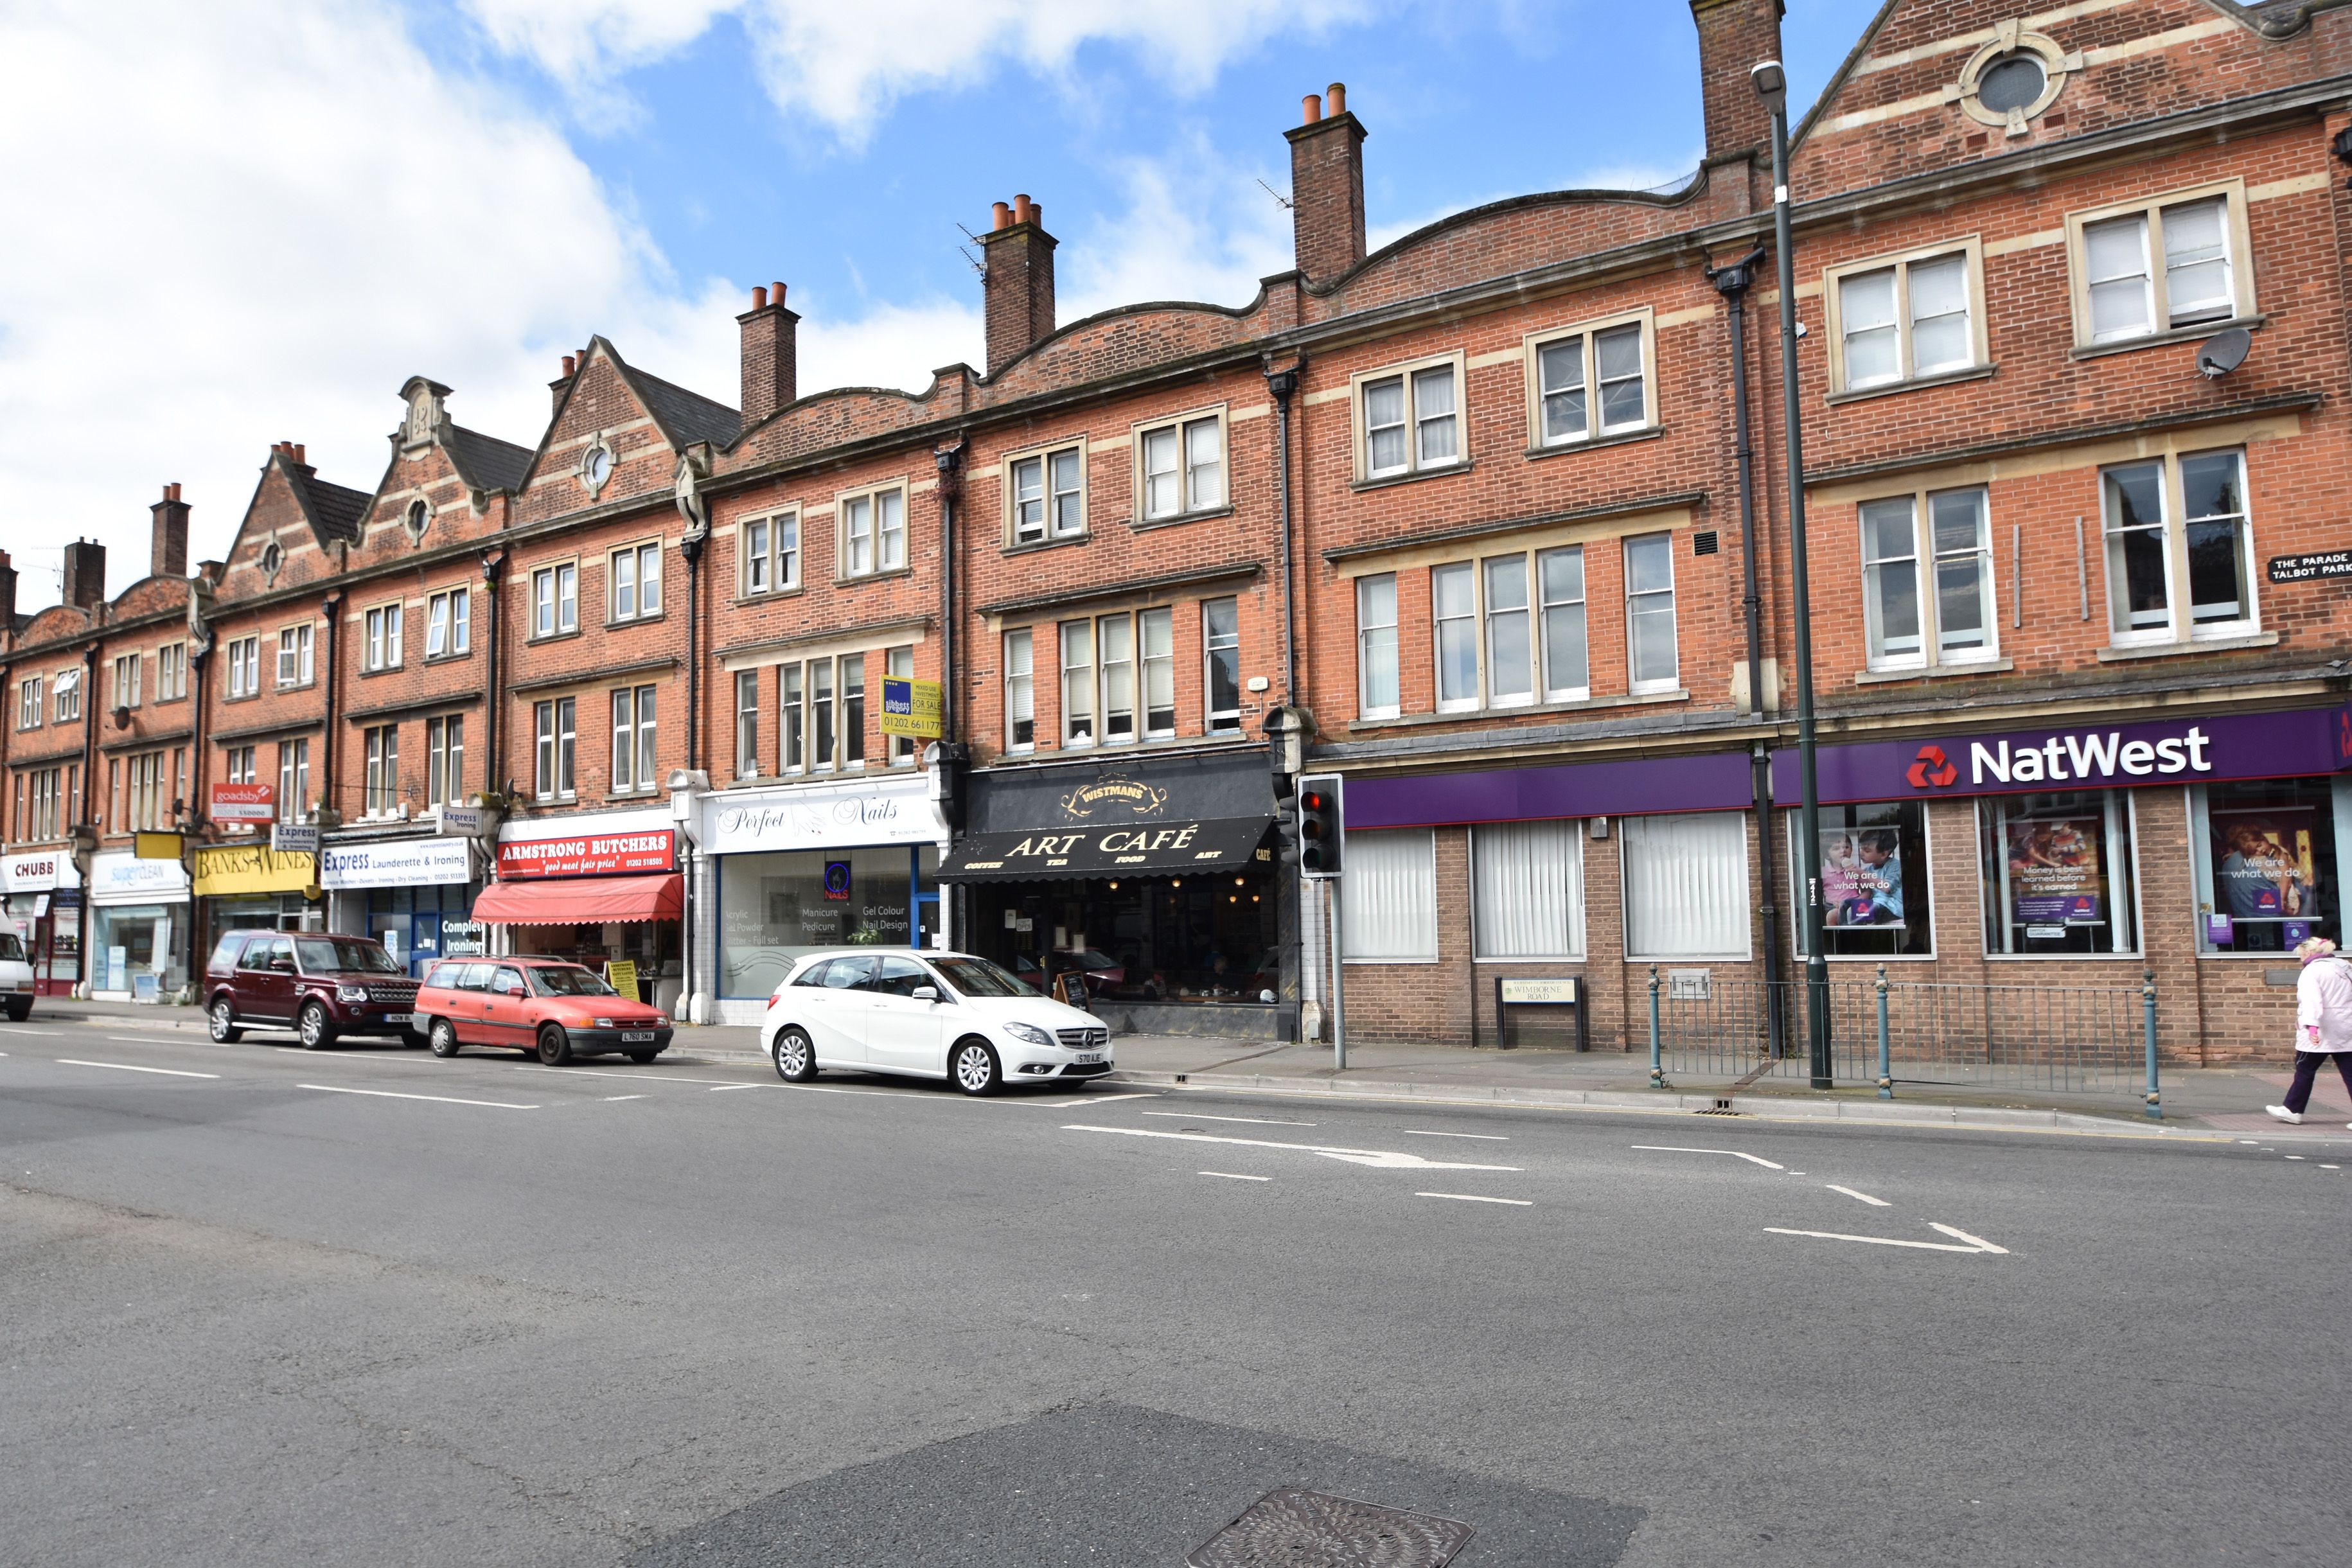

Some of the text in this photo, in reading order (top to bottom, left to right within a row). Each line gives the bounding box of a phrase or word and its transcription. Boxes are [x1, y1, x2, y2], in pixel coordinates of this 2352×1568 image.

[2275, 553, 2348, 569] THE PARADE
[2272, 563, 2352, 579] TALBOT PARK
[885, 699, 910, 707] sibbett
[885, 705, 910, 714] gregory
[912, 699, 941, 710] FOR SALE
[884, 716, 940, 730] 01202 661177
[1970, 727, 2211, 784] NatWest
[216, 790, 260, 804] goadsby
[1082, 786, 1144, 803] WISTMANS
[443, 812, 477, 823] Express
[718, 796, 897, 838] Perfect Nails
[279, 825, 315, 839] Express
[456, 822, 477, 830] Ironing
[1005, 824, 1199, 857] ART CAFÉ
[502, 835, 668, 861] ARMSTRONG BUTCHERS
[1256, 847, 1271, 861] CAFÉ
[196, 846, 312, 880] BANKS WINES
[324, 851, 464, 877] Express Launderette & Ironing
[561, 859, 578, 870] meat
[580, 858, 596, 873] fair
[626, 859, 642, 867] 01202
[643, 857, 664, 867] 518505
[964, 850, 1223, 870] COFFEE TEA FOOD ART
[2243, 858, 2262, 867] We
[15, 861, 54, 877] CHUBB
[2023, 867, 2053, 875] Money
[2231, 869, 2262, 878] what
[2285, 867, 2301, 877] do
[1834, 881, 1858, 890] what
[1877, 880, 1890, 888] do
[824, 889, 849, 899] NAILS
[802, 908, 838, 918] Manicure
[862, 905, 905, 916] Gel Colour
[737, 922, 764, 931] Powder
[802, 922, 835, 932] Pedicure
[862, 919, 908, 931] Nail Design
[447, 938, 482, 955] Ironing
[753, 935, 766, 945] Full
[767, 936, 779, 945] set
